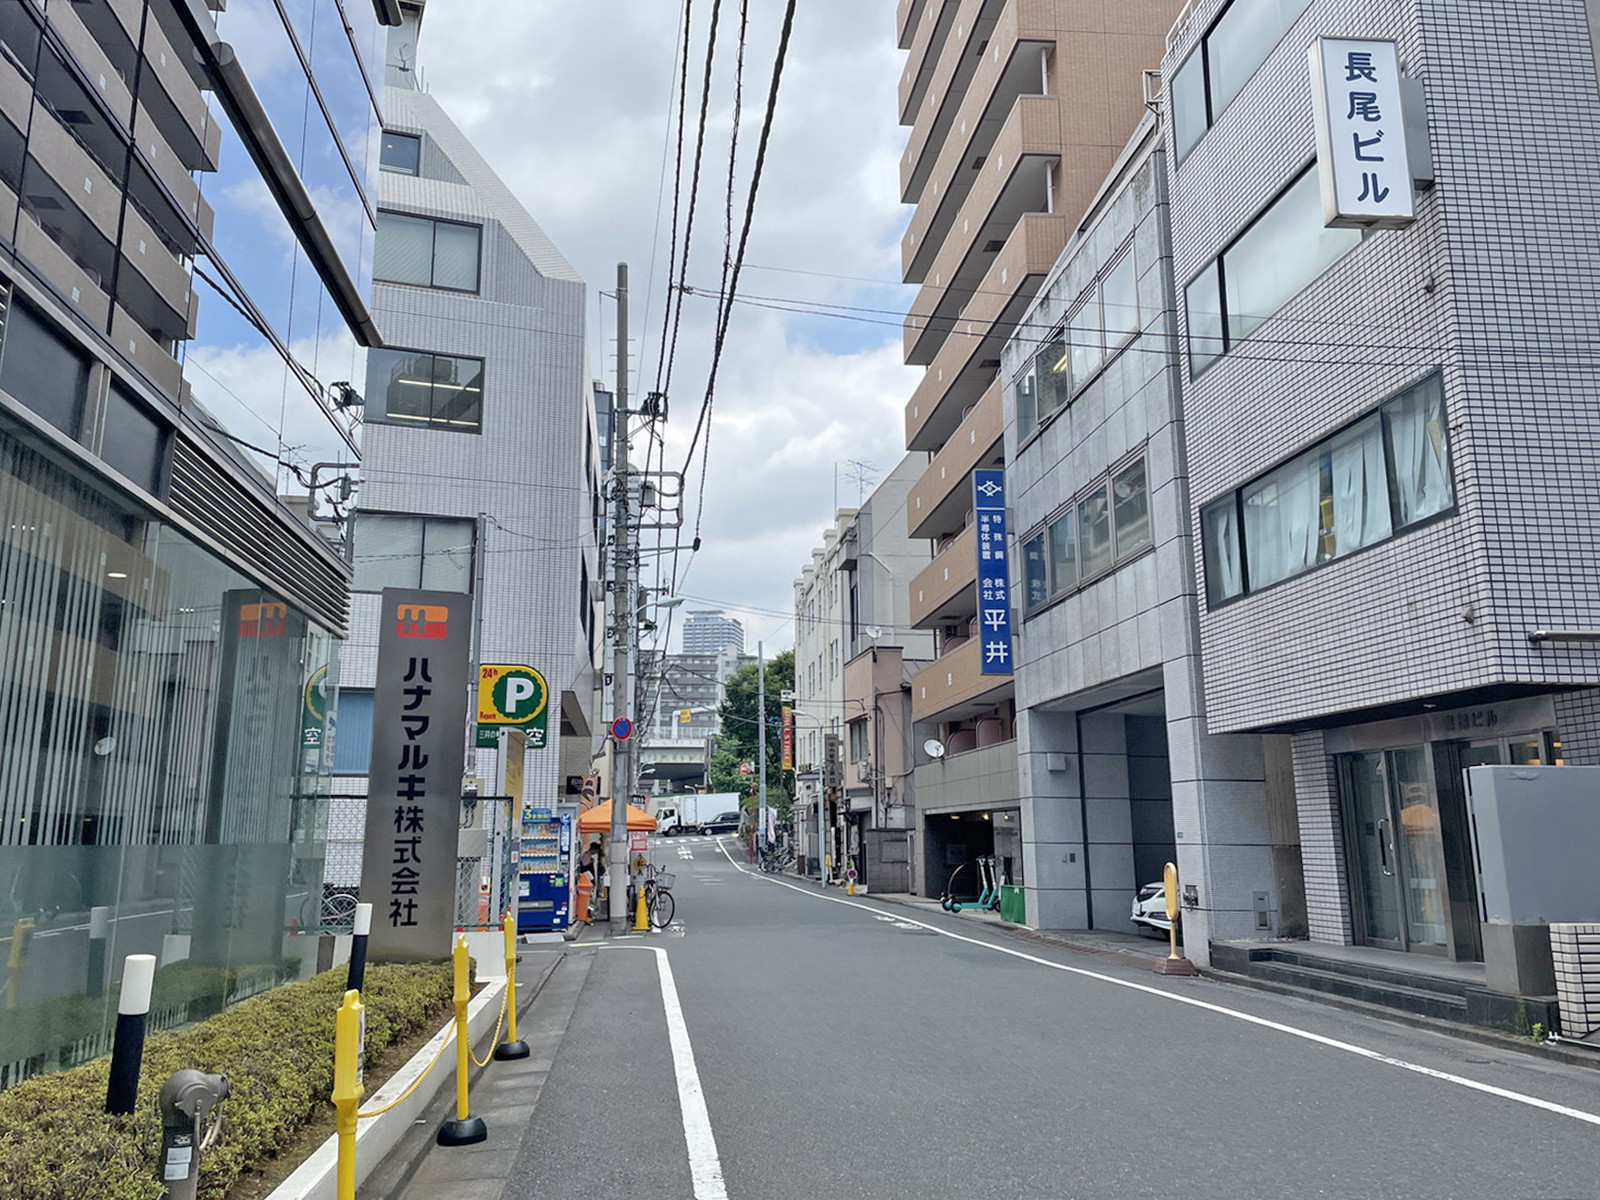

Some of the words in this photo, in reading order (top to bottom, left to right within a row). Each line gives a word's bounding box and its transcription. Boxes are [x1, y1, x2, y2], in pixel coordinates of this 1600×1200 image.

[1344, 51, 1390, 204] 長尾ビル
[982, 577, 994, 601] 会社
[994, 578, 1006, 601] 株式
[984, 608, 1008, 663] 平井
[505, 677, 535, 713] P
[388, 657, 433, 928] ハナマルキ株式会社
